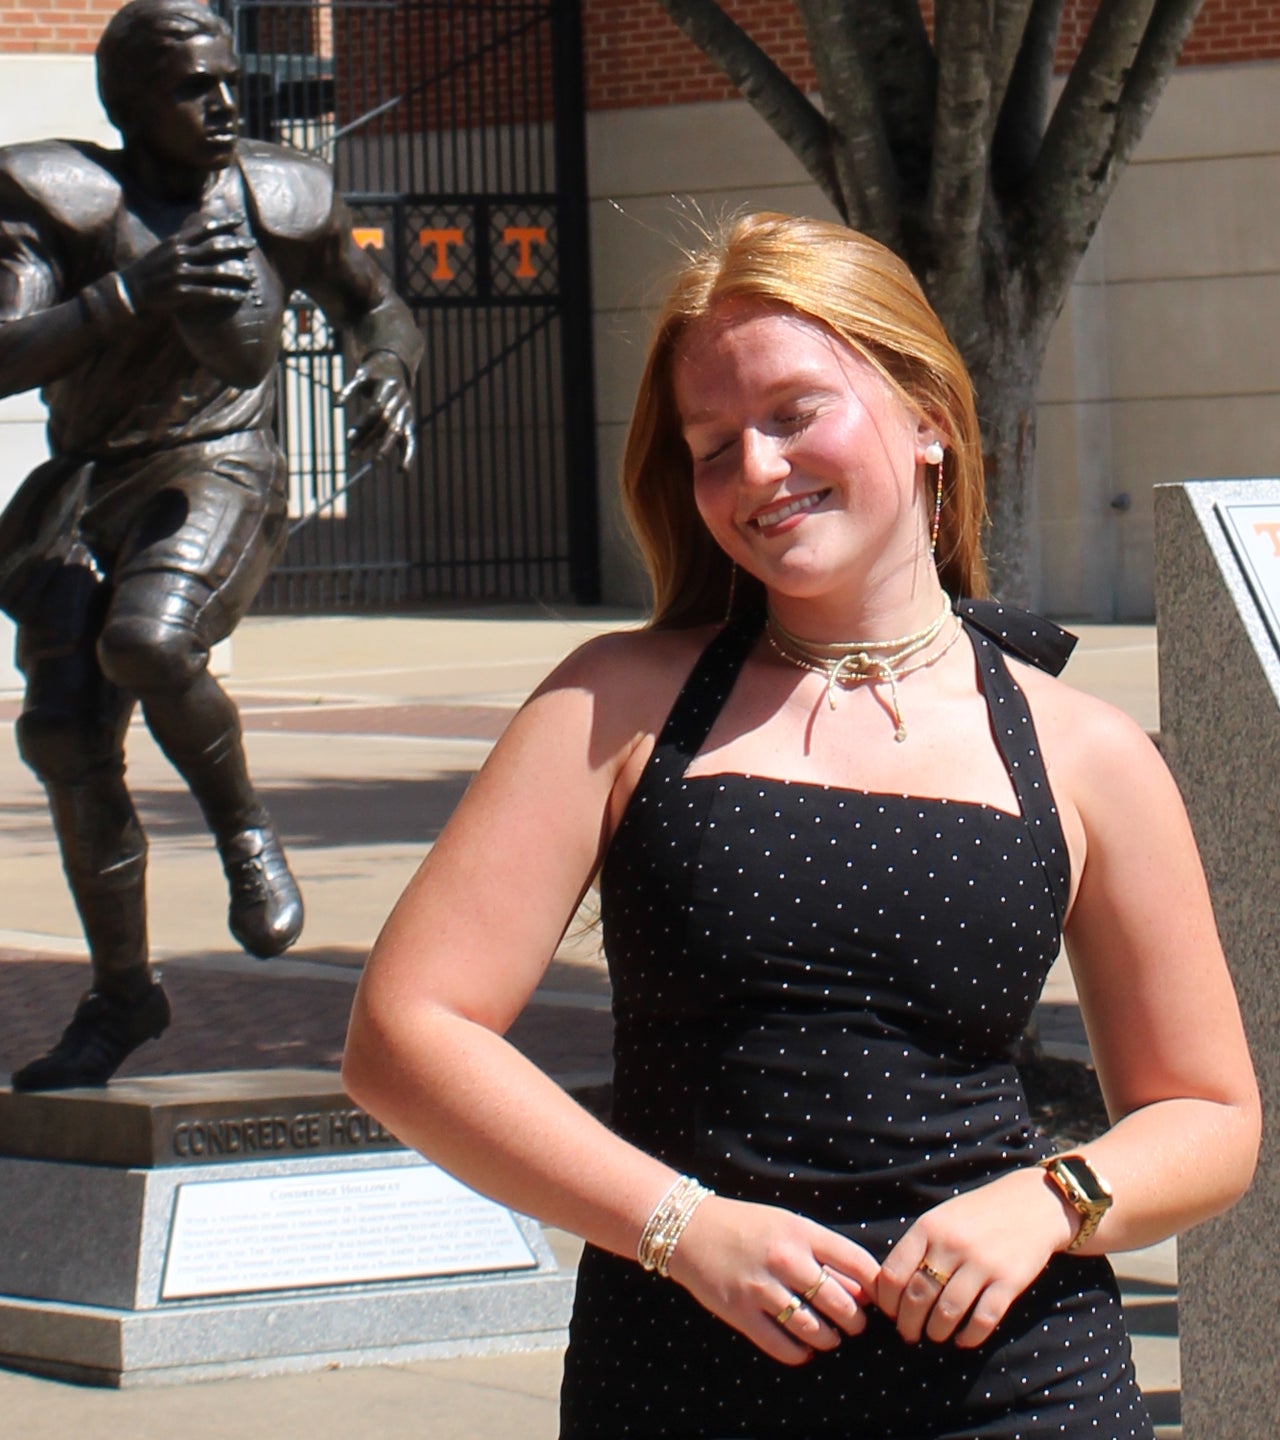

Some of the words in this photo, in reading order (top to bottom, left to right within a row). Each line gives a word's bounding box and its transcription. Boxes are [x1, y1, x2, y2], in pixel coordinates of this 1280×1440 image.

[419, 229, 463, 280] T
[503, 227, 546, 278] T
[172, 1113, 321, 1157] CONDREDGE
[328, 1109, 392, 1145] HOLL
